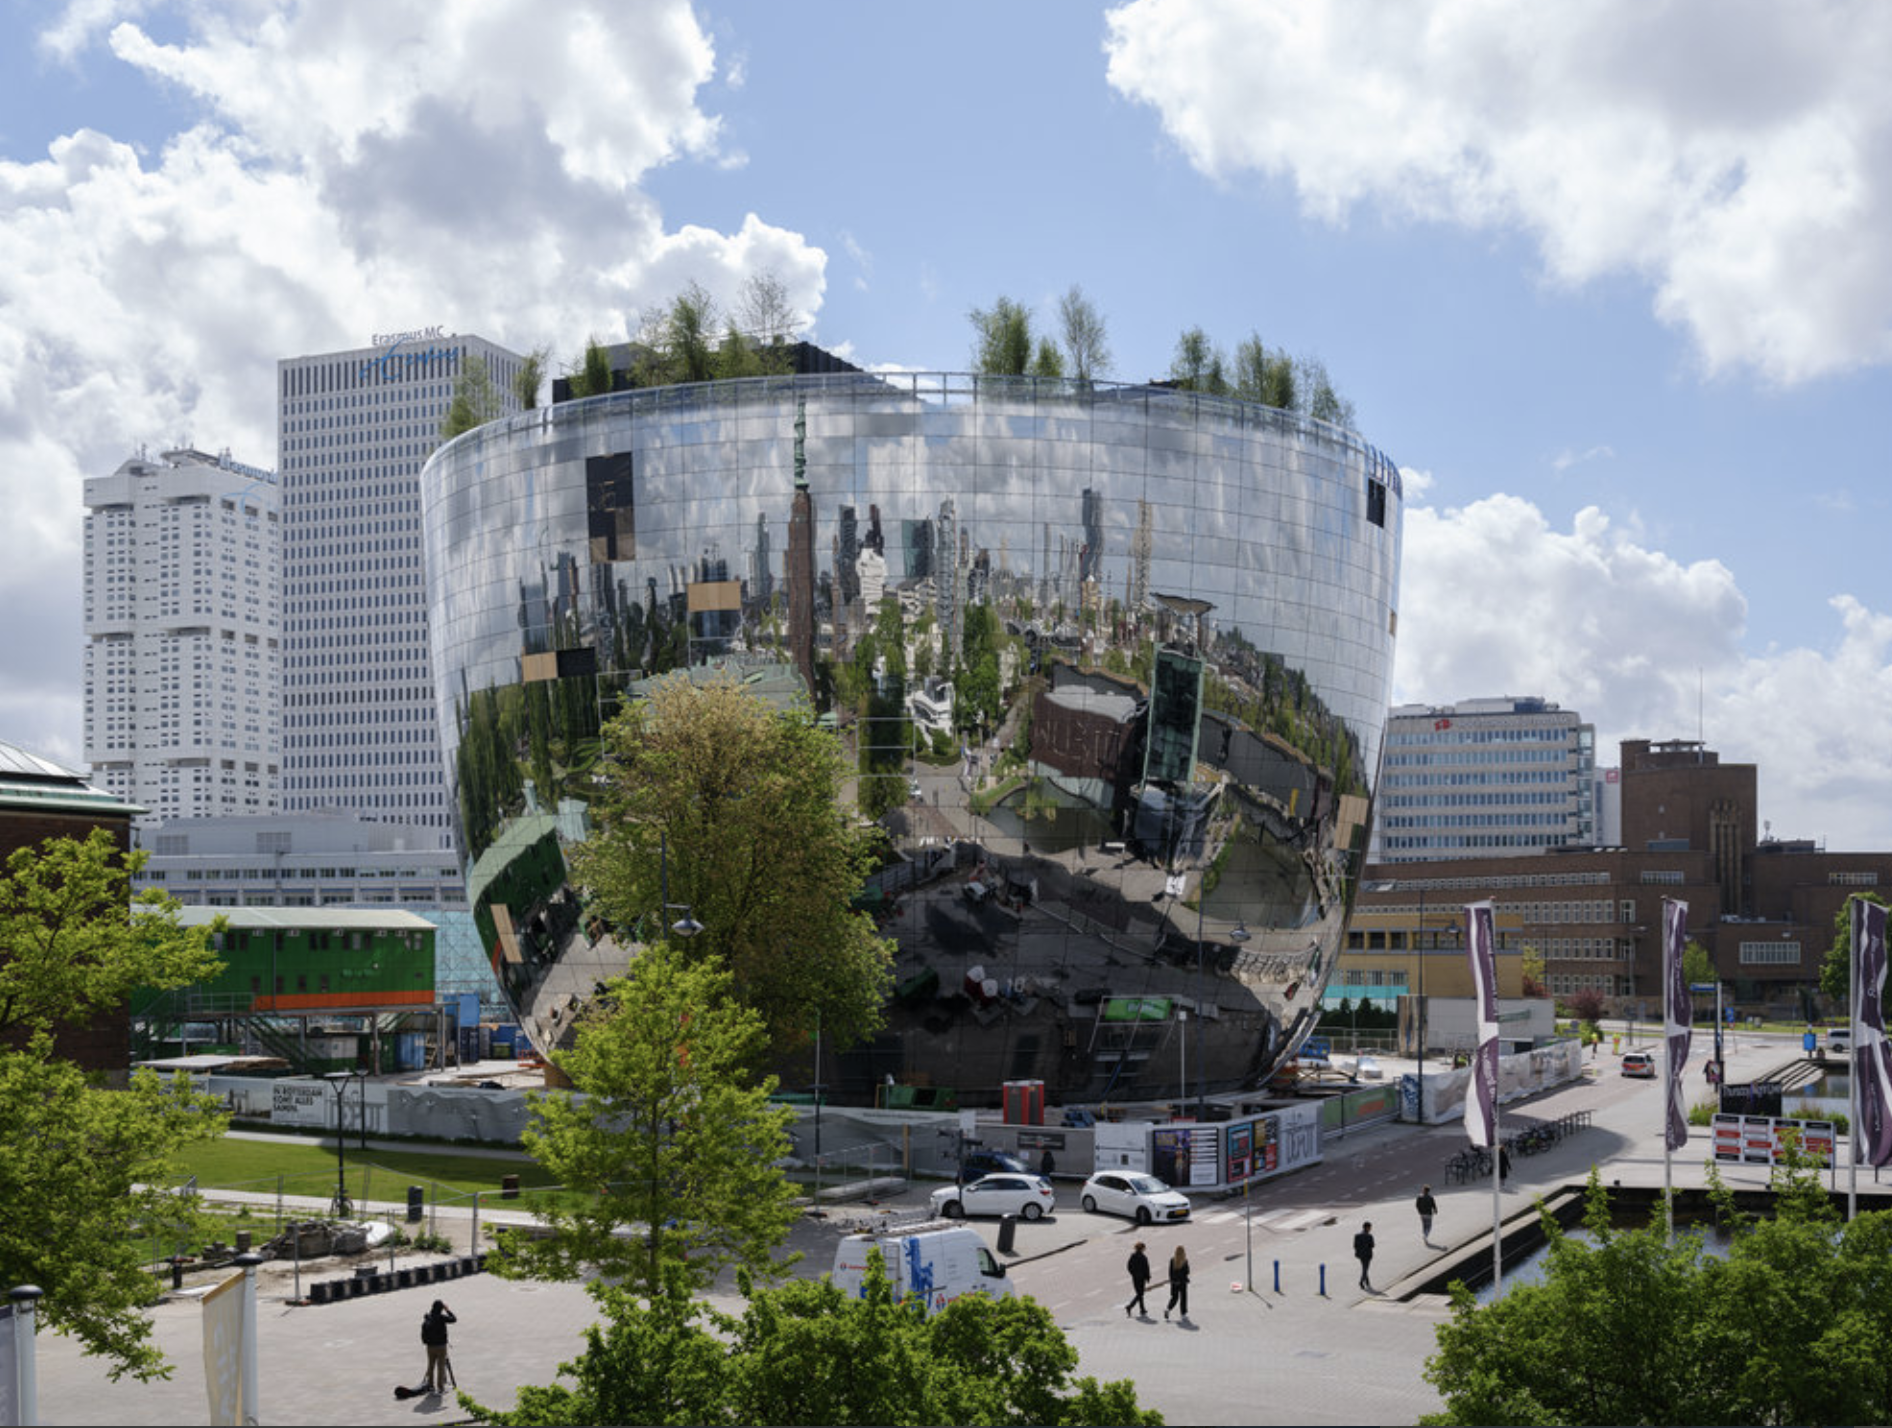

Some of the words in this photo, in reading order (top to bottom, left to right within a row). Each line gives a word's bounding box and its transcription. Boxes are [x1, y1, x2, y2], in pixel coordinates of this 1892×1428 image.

[372, 330, 422, 345] Erasmus
[425, 325, 443, 339] MC
[283, 1086, 322, 1096] ROTTERDAM
